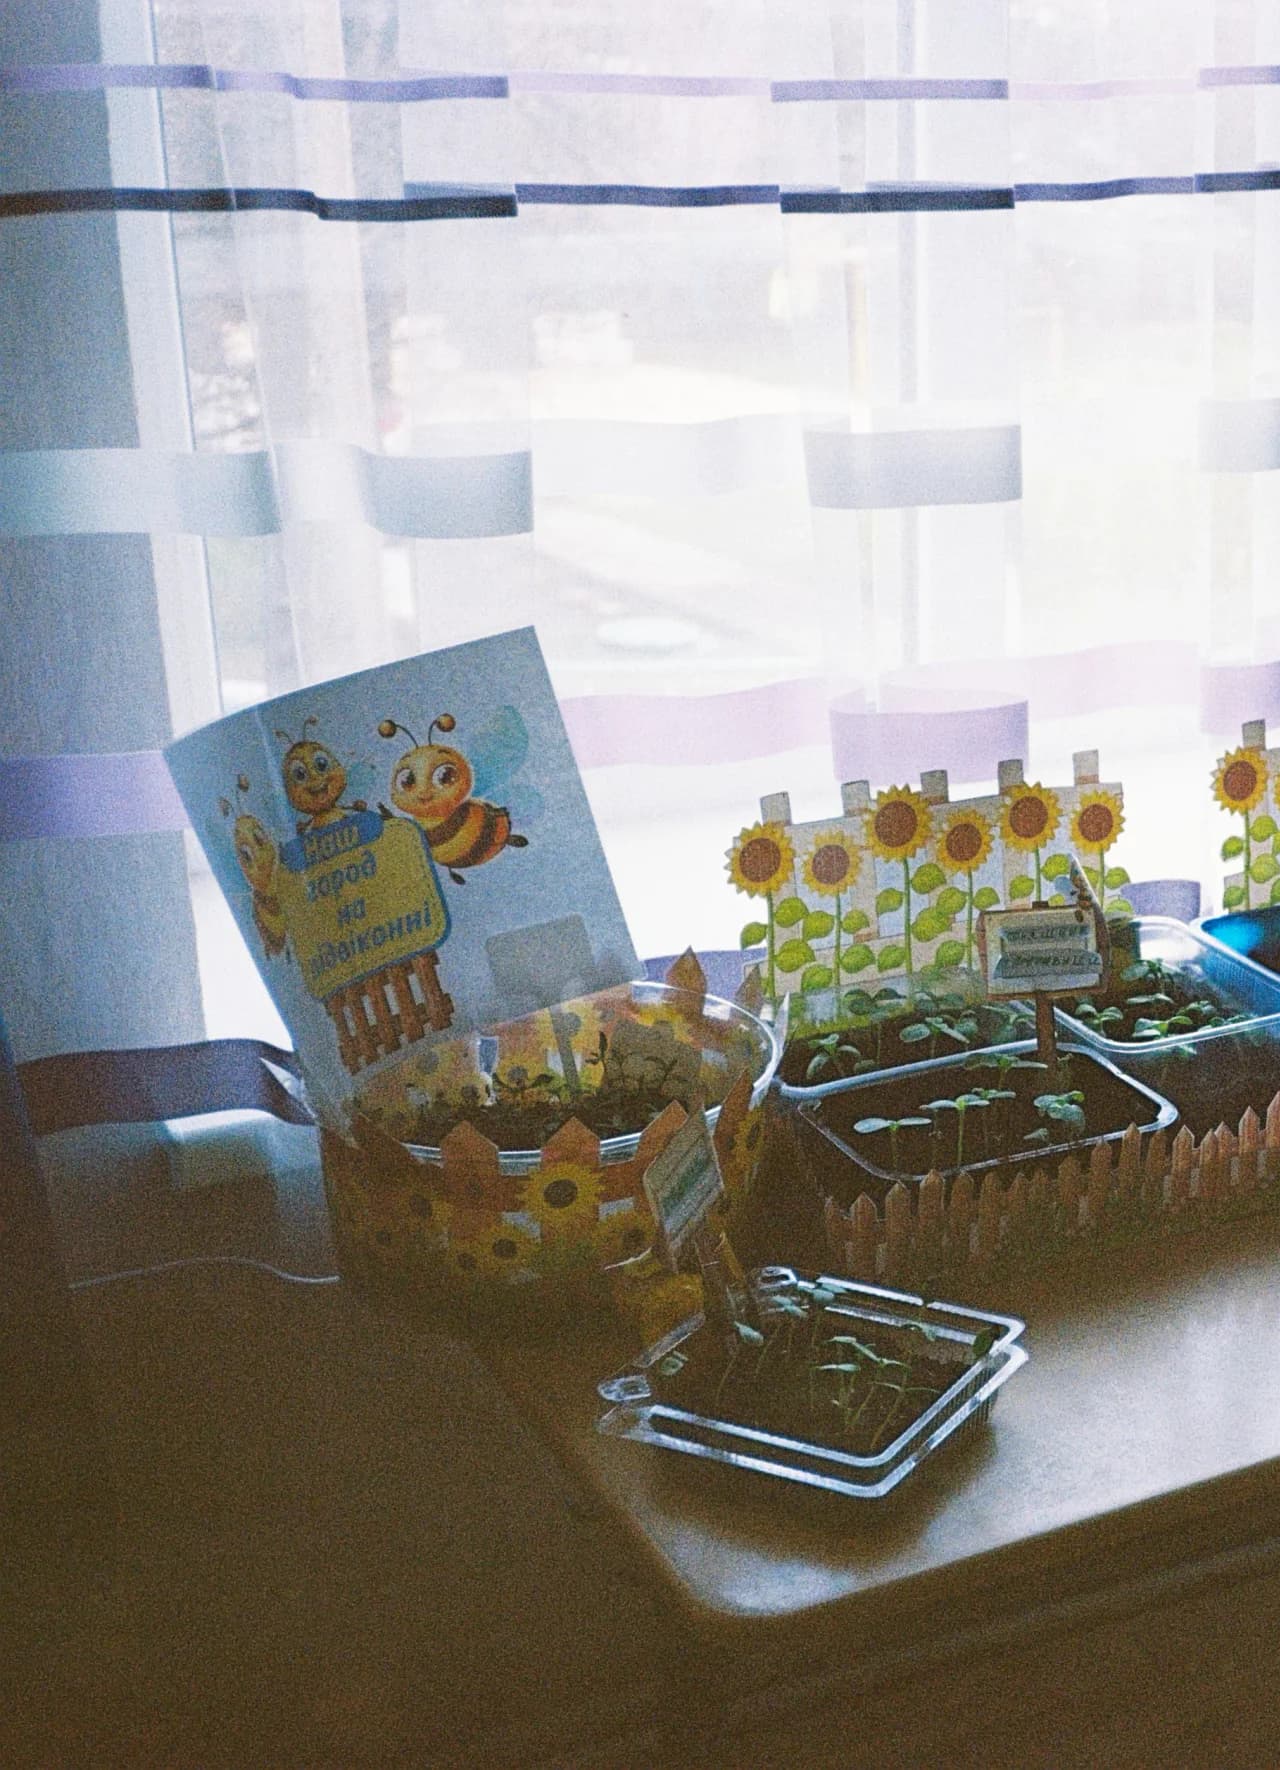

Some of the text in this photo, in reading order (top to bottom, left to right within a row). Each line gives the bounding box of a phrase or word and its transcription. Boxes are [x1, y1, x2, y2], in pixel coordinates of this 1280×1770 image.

[303, 825, 361, 862] Наш
[306, 850, 377, 903] город
[337, 898, 367, 928] на
